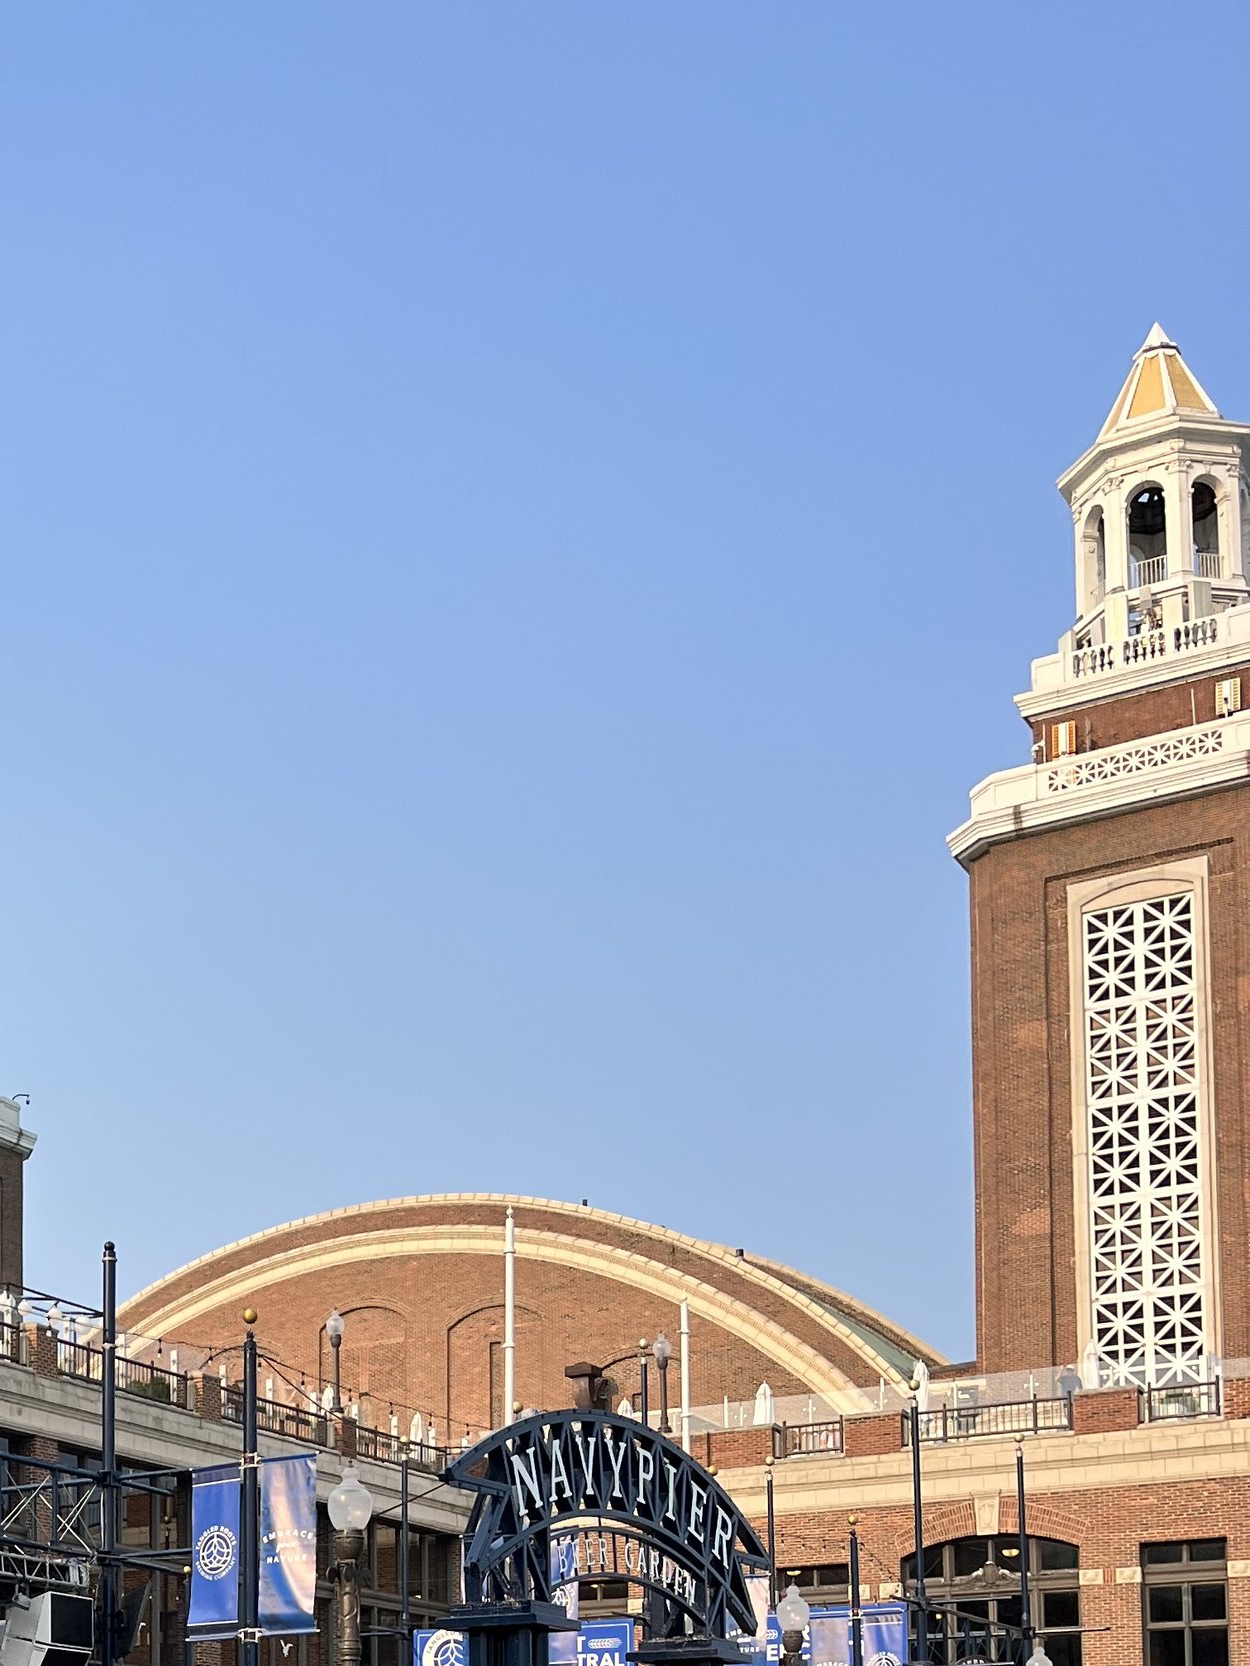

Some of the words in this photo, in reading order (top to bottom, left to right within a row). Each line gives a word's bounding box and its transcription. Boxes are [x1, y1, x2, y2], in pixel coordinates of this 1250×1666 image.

[510, 1436, 626, 1517] NAVY
[636, 1447, 732, 1570] PIER
[219, 1525, 237, 1546] ROOTS
[262, 1528, 314, 1544] EMBRACE
[267, 1553, 307, 1565] NATURE
[558, 1538, 608, 1575] BEER
[624, 1542, 697, 1607] GARDEN
